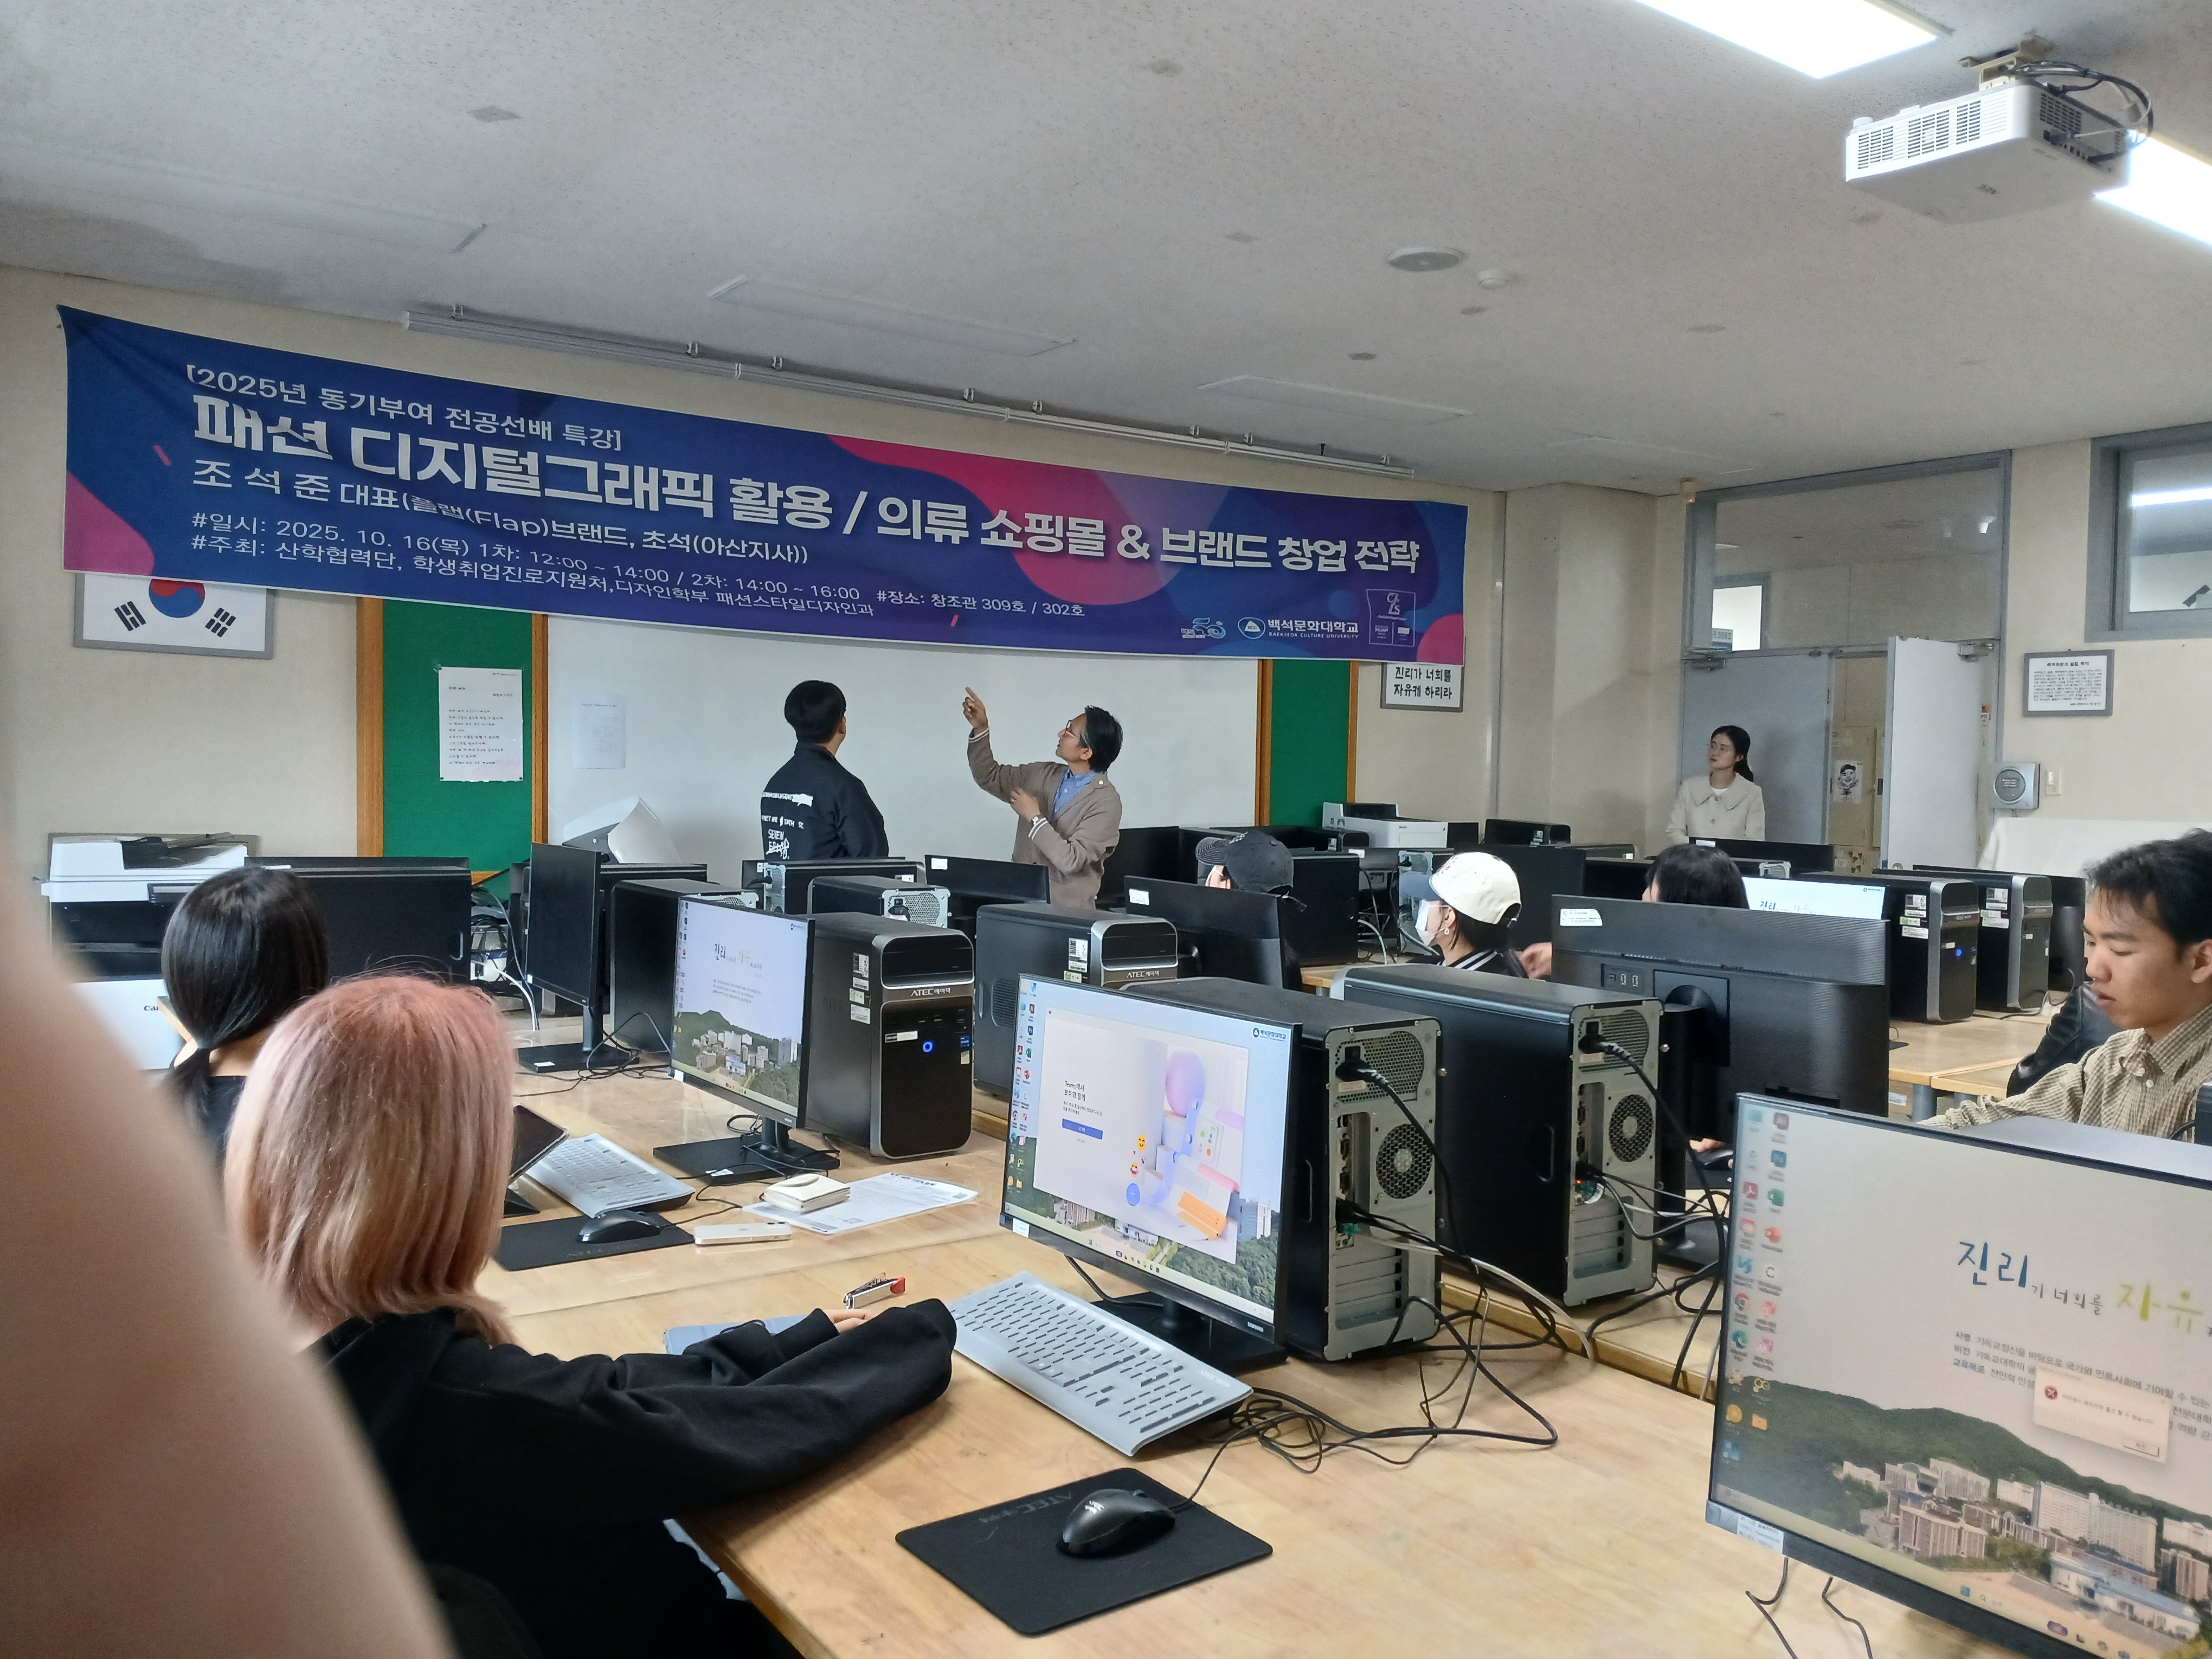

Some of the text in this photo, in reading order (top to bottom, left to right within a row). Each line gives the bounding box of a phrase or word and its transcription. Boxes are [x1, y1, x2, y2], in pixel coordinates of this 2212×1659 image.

[318, 387, 433, 425] 동기부여
[445, 407, 552, 441] 전공선배
[562, 423, 621, 451] 특강]
[192, 394, 1420, 575] 패션 디지털그래픽 활용 / 의류 쇼핑몰 & 브랜드 창업 전략
[192, 459, 233, 488] 조
[244, 467, 281, 494] 석
[293, 473, 331, 502] 준
[642, 530, 808, 564] 초석(아산지사))
[191, 512, 266, 535] #일시:
[276, 520, 345, 542] 2025.
[357, 529, 392, 548] 10.
[403, 535, 469, 556] 16(목)
[478, 543, 520, 562] 1차:
[529, 551, 588, 570] 12:00
[613, 565, 669, 583] 14:00
[691, 573, 728, 589] 2차:
[735, 577, 788, 594] 14:00
[810, 584, 860, 600] 16:00
[876, 589, 925, 605] #장소:
[930, 593, 978, 610] 창조관
[981, 597, 1027, 613] 309호
[1031, 601, 1038, 615] /
[1041, 602, 1085, 617] 302호
[191, 534, 266, 557] #주최:
[275, 542, 402, 571] 산학협력단,
[716, 591, 874, 616] 패션스타일디자인과
[1268, 619, 1359, 634] 백석문화대학교
[1393, 683, 1452, 700] 자유케 하리라
[1394, 666, 1451, 683] 진리가 너희를
[768, 828, 785, 841] SEVEN
[2054, 1288, 2104, 1315] 너희를
